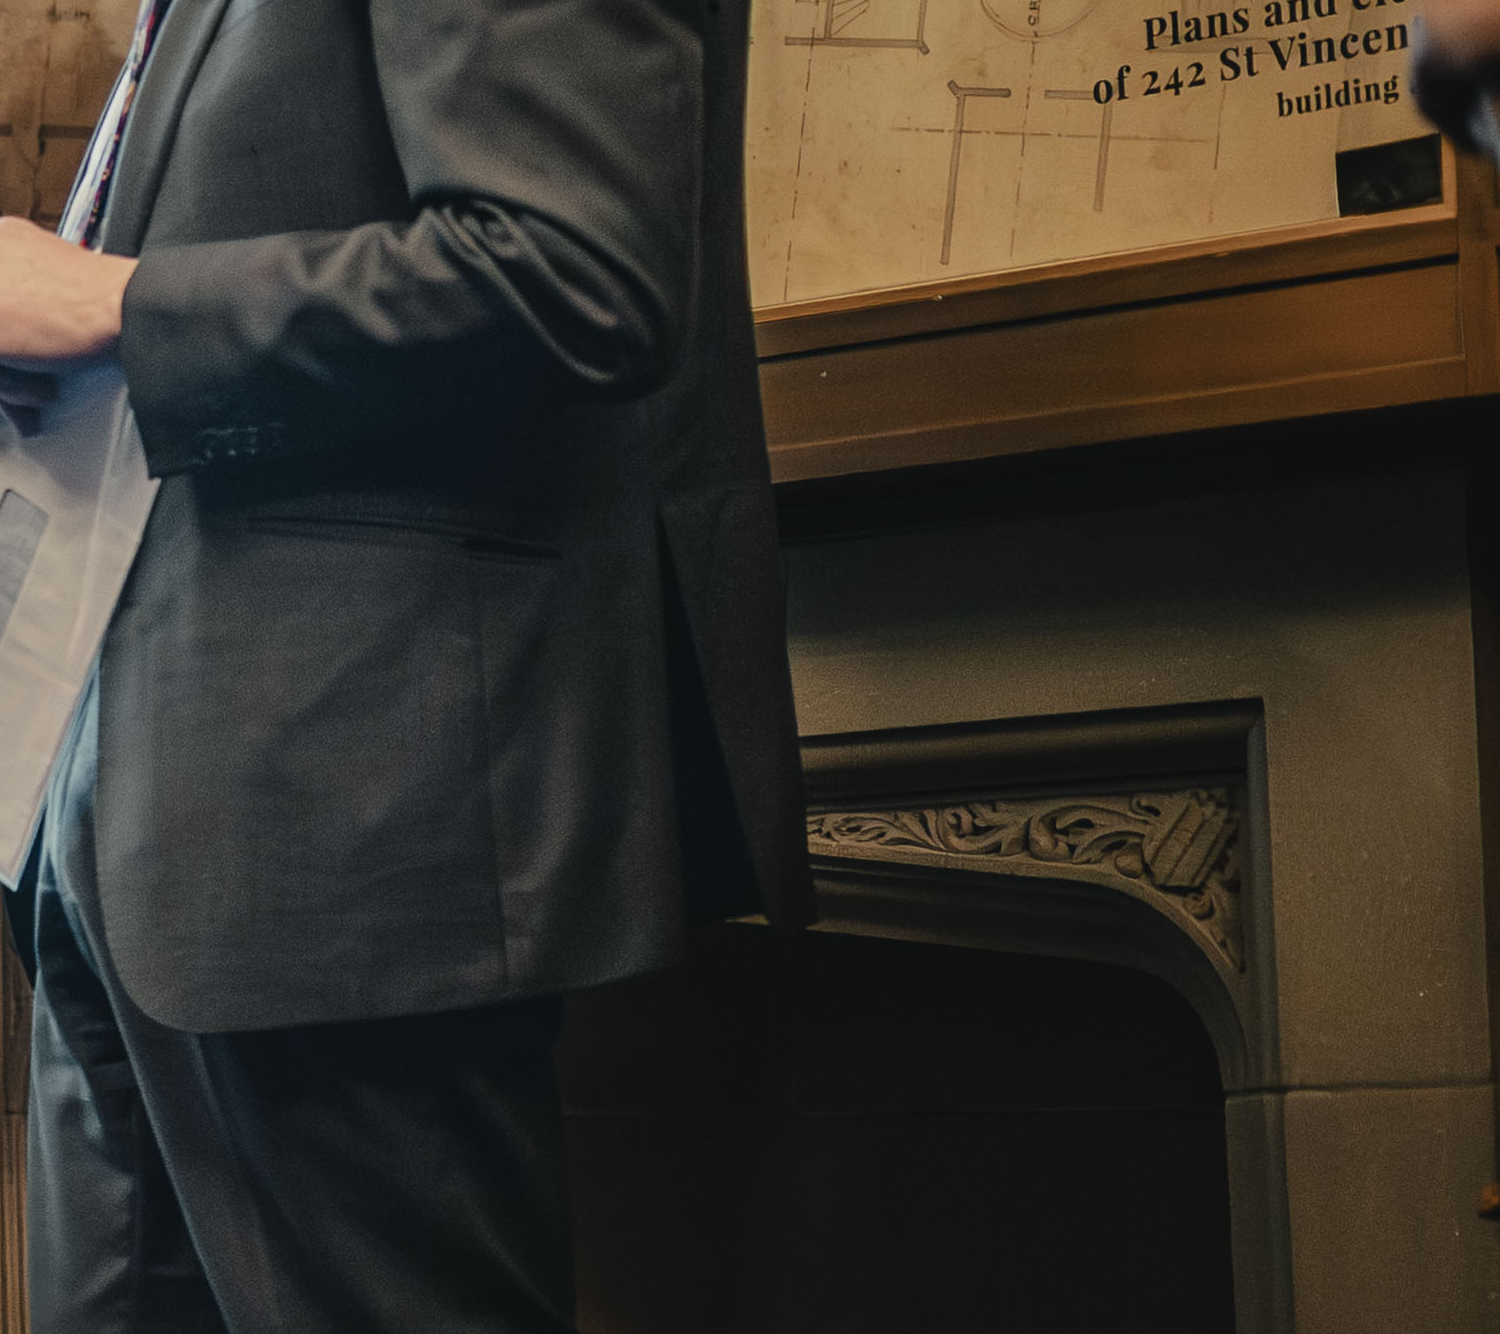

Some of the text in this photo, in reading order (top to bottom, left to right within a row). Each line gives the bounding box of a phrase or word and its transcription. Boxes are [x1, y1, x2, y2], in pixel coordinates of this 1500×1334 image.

[1143, 7, 1250, 51] Plans
[1093, 22, 1409, 104] of 242 St Vincen
[1277, 75, 1399, 118] building
